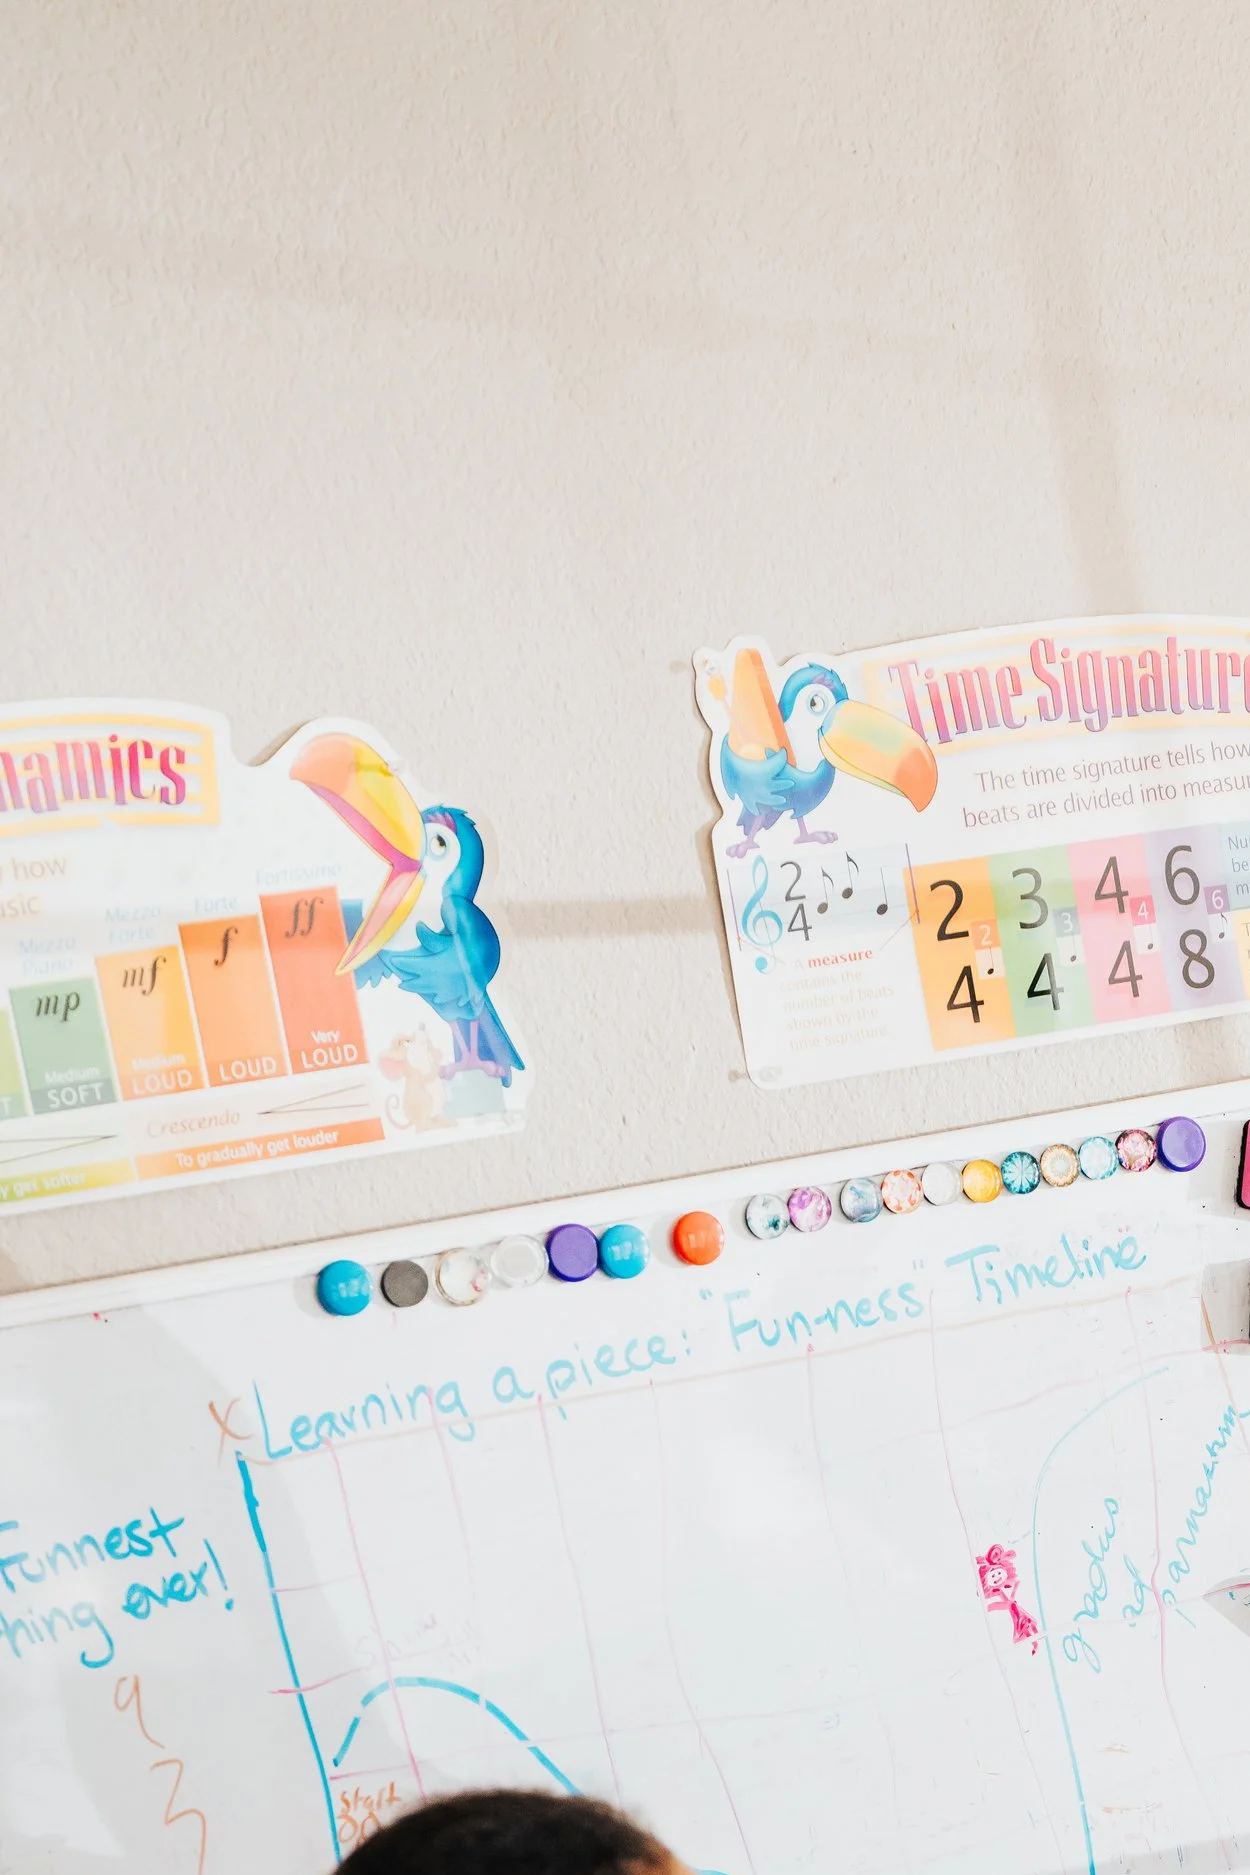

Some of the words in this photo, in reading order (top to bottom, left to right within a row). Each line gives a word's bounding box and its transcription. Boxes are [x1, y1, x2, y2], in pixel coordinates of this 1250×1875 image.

[888, 659, 1027, 744] Time
[0, 735, 187, 814] namics
[974, 770, 1016, 793] The
[1022, 766, 1067, 788] time
[1072, 753, 1162, 784] signature
[1167, 744, 1207, 768] tells
[962, 801, 1020, 829] beats
[1026, 800, 1058, 820] are
[1063, 784, 1135, 815] divided
[1139, 780, 1178, 803] into
[11, 856, 67, 881] how
[256, 864, 342, 887] Fortissimo
[780, 861, 806, 902] 2
[1164, 844, 1201, 906] 6
[1011, 867, 1049, 930] 3
[1094, 856, 1129, 914] 4
[194, 895, 238, 914] Forte
[930, 879, 970, 942] 2
[1137, 901, 1149, 921] 4
[1211, 889, 1225, 910] 6
[104, 905, 162, 924] Mezzo
[787, 902, 813, 942] 4
[1060, 912, 1074, 934] 3
[19, 937, 77, 956] Mezzo
[108, 926, 155, 944] Forte
[979, 924, 993, 946] 2
[807, 949, 874, 970] measure
[1108, 940, 1143, 998] 4
[1179, 928, 1216, 990] 8
[858, 985, 895, 1001] beats
[946, 964, 985, 1024] 4
[1027, 952, 1065, 1011] 4
[310, 1029, 341, 1045] Very
[218, 1056, 278, 1082] LOUD
[301, 1043, 359, 1070] LOUD
[44, 1066, 101, 1085] Medium
[132, 1069, 194, 1096] LOUD
[47, 1082, 105, 1109] SOFT
[146, 1110, 241, 1138] Crescendo
[175, 1152, 195, 1168] To
[196, 1140, 264, 1168] gradually
[266, 1137, 291, 1157] get
[293, 1129, 340, 1150] louder
[253, 1379, 475, 1460] Learning
[491, 1365, 536, 1403] a
[945, 1231, 1149, 1305] Timeline
